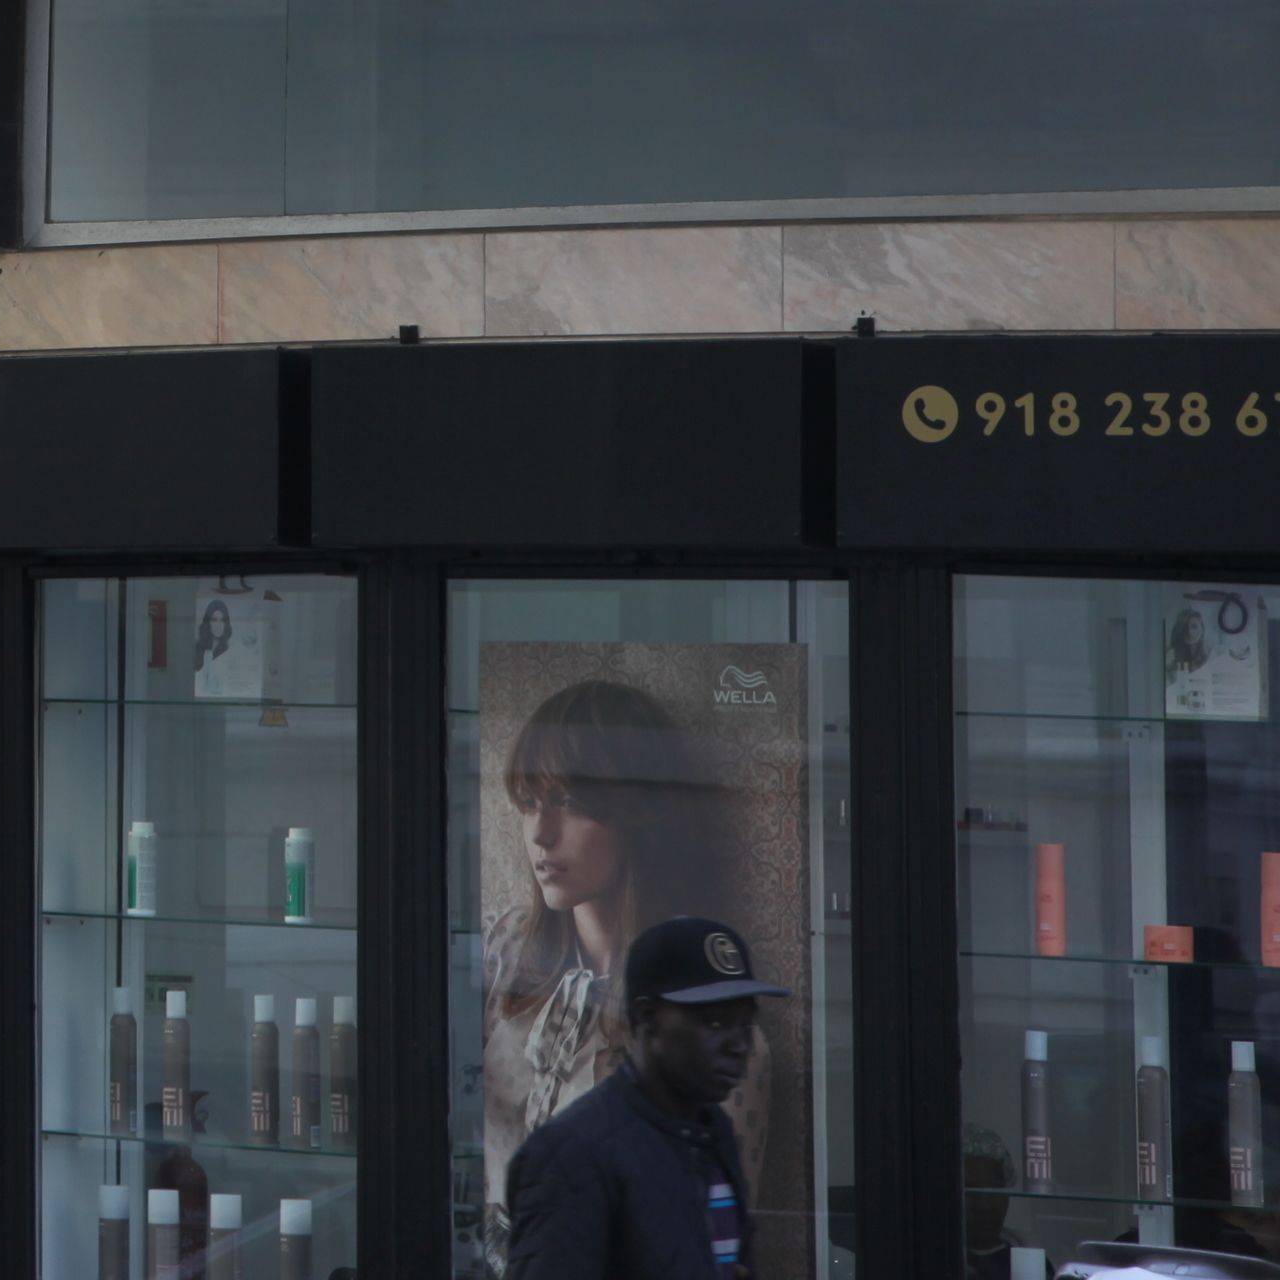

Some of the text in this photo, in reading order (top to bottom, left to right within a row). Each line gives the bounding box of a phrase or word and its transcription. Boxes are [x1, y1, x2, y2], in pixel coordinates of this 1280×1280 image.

[975, 392, 1280, 437] 918 238 6
[713, 689, 777, 705] WELLA
